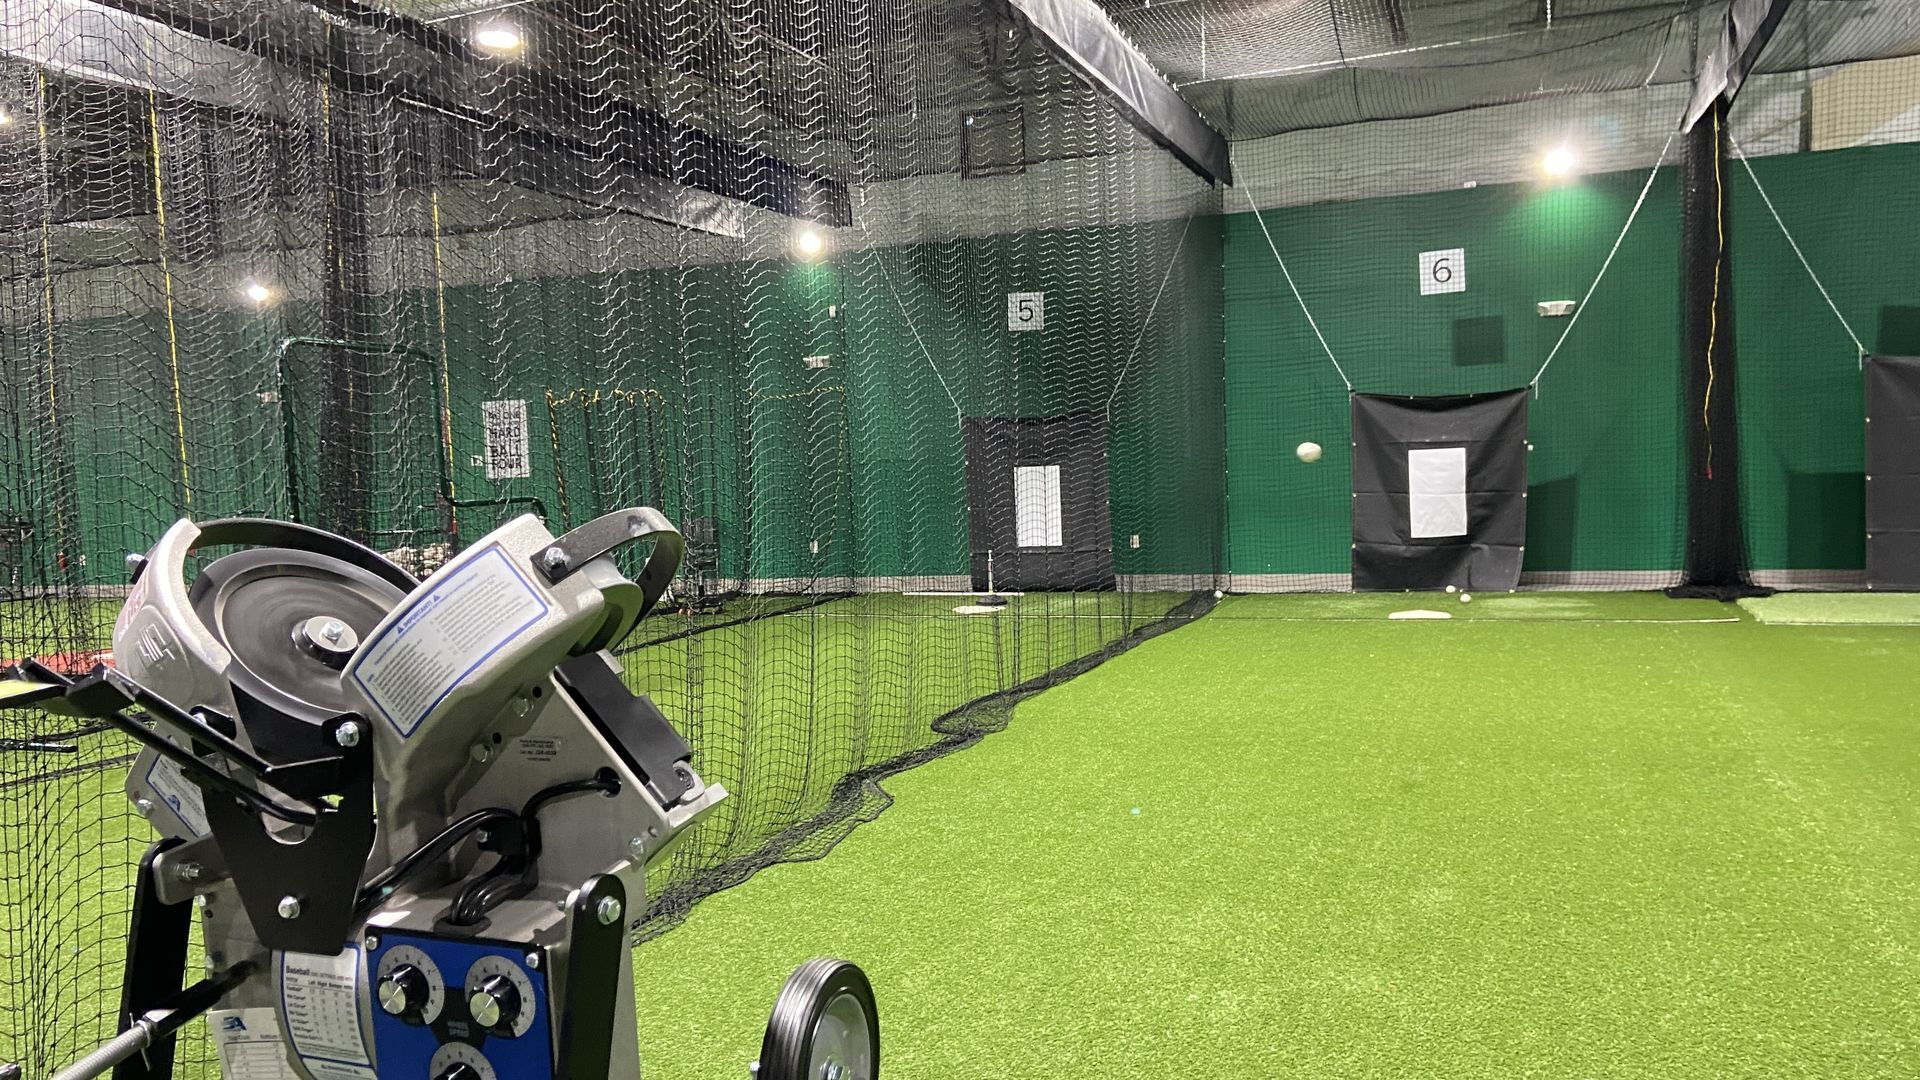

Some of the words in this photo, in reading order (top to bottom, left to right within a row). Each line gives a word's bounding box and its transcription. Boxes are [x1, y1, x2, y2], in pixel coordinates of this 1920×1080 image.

[1433, 258, 1452, 283] 6
[1019, 299, 1034, 322] 5
[490, 445, 522, 457] BALL
[286, 965, 310, 976] Baseball
